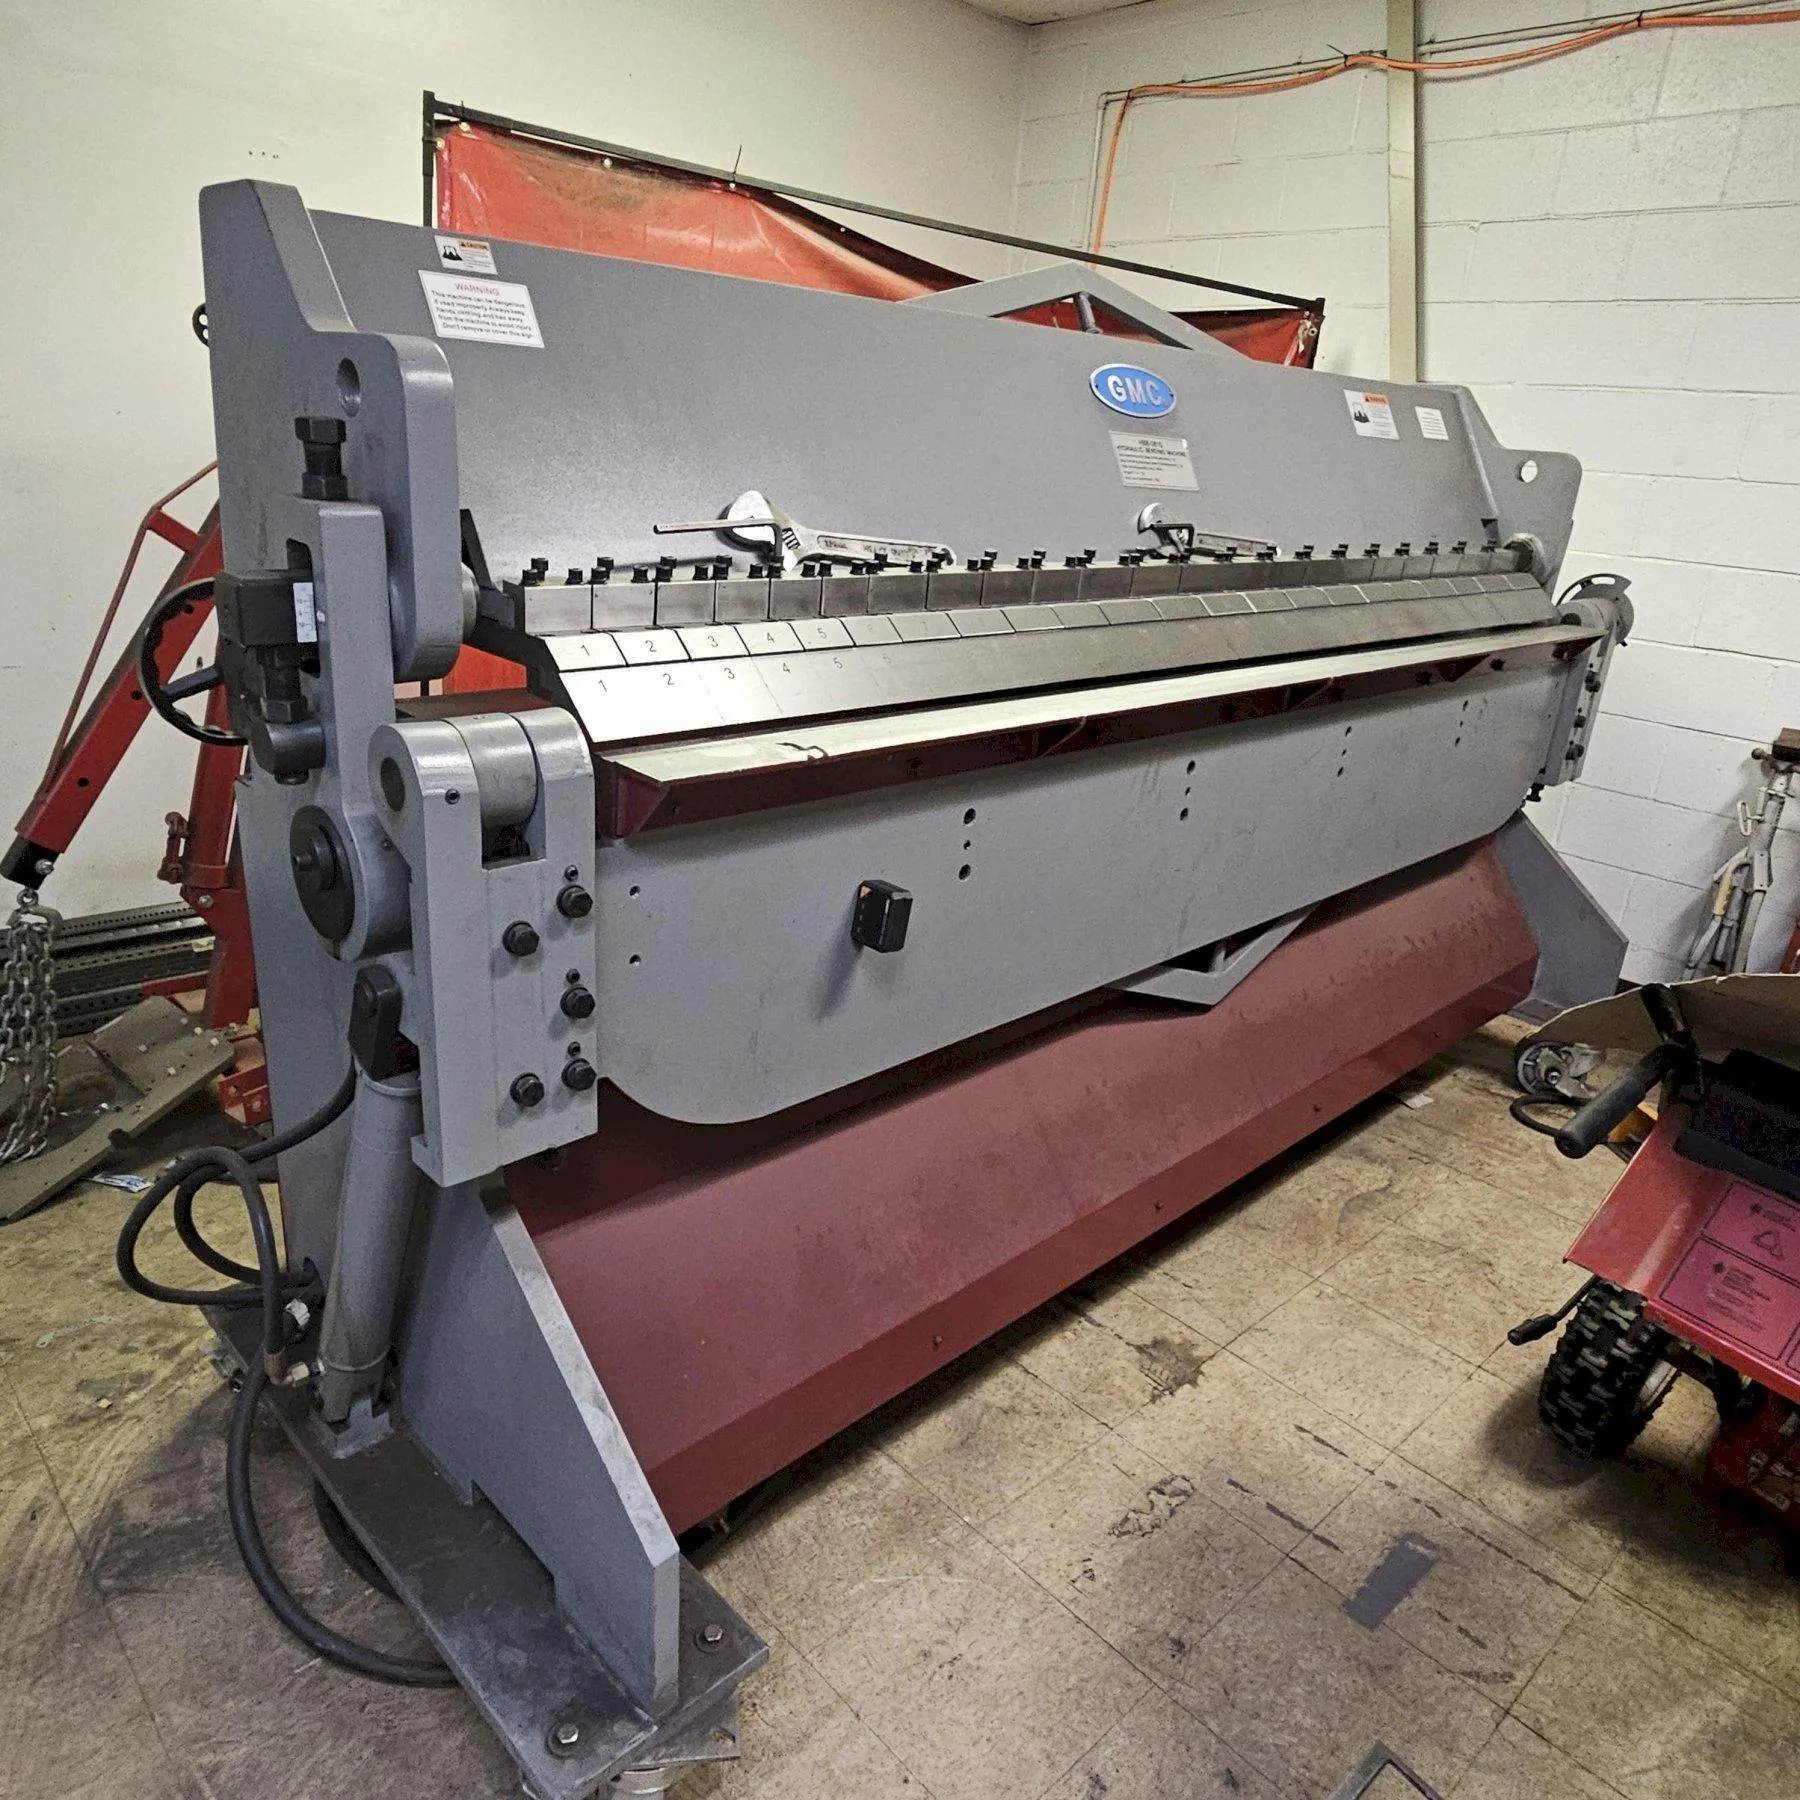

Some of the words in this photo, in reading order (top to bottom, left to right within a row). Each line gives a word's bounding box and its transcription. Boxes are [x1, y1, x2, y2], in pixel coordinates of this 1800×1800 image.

[431, 290, 446, 298] This
[447, 293, 472, 301] machine
[494, 299, 525, 308] dangerous
[455, 283, 499, 296] WARNING
[465, 318, 490, 326] machine
[1107, 374, 1164, 405] GMC
[581, 644, 590, 656] 1
[645, 640, 657, 652] 2
[707, 635, 719, 648] 3
[766, 631, 775, 643] 4
[817, 627, 828, 640] 5
[598, 679, 607, 692] 1
[662, 672, 675, 686] 2
[724, 667, 735, 680] 3
[782, 662, 791, 674] 4
[833, 657, 844, 670] 5
